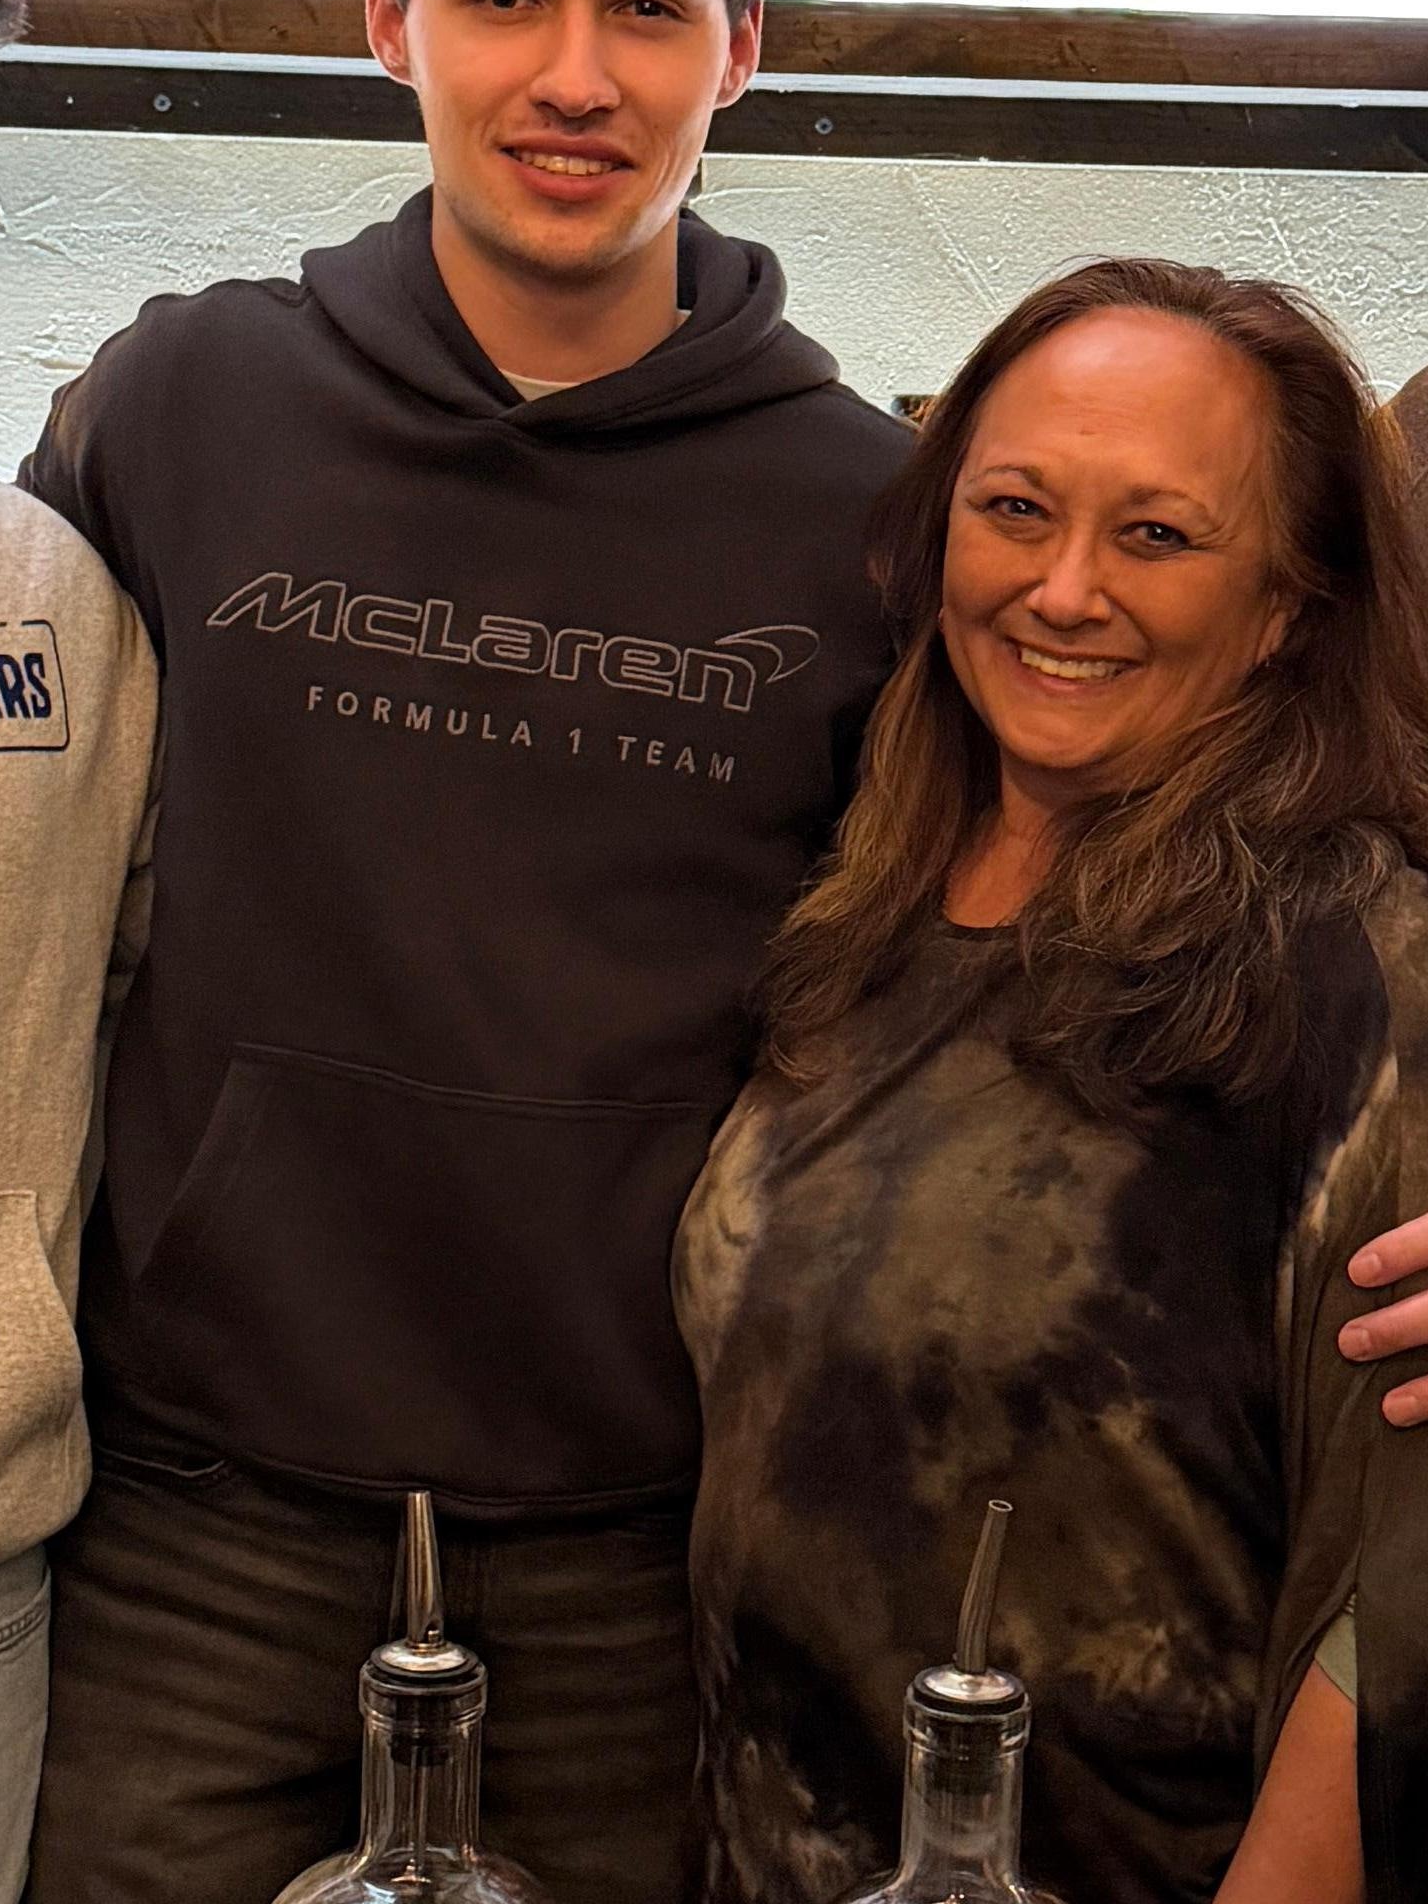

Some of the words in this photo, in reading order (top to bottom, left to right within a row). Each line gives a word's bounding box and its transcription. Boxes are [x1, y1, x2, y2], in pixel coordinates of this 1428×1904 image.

[205, 570, 756, 713] McLaren
[306, 684, 535, 747] FORMULA
[568, 727, 582, 755] 1
[617, 734, 736, 784] TEAM
